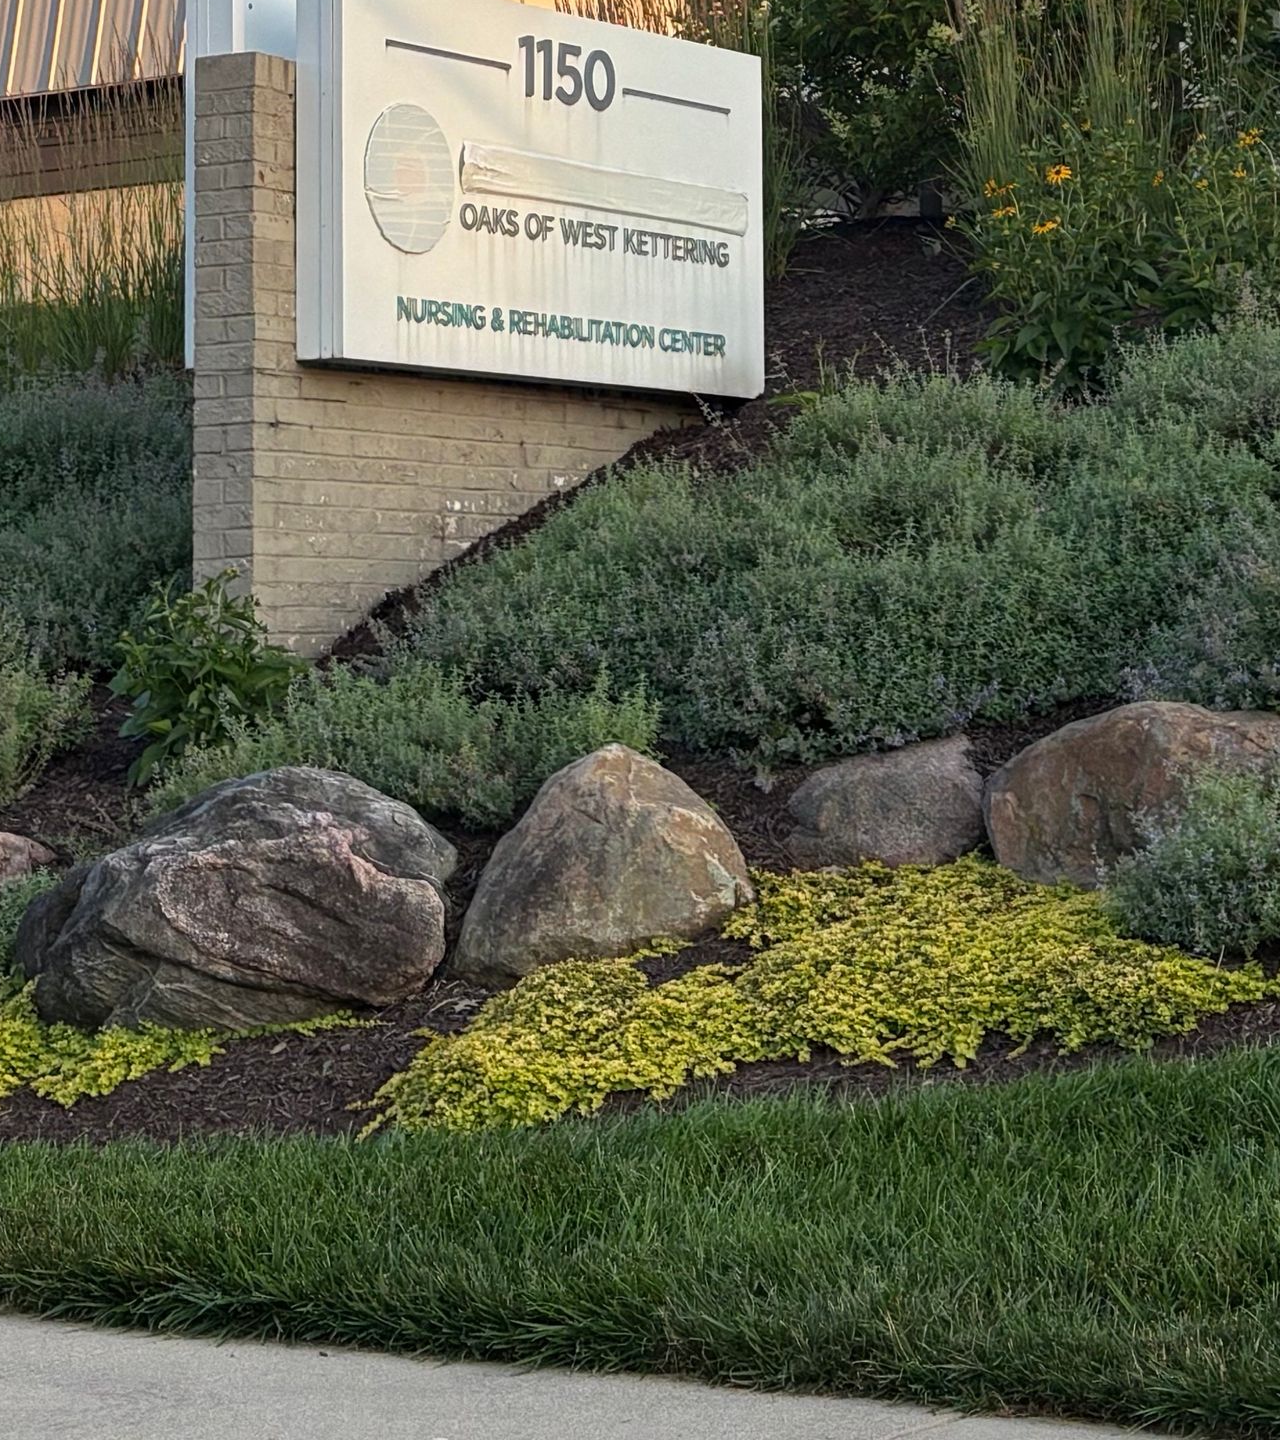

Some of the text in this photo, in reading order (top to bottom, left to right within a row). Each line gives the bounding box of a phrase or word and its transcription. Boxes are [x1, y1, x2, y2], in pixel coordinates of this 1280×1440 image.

[518, 35, 616, 111] 1150
[459, 203, 730, 268] OAKS OF WEST KETTERING
[396, 296, 726, 358] NURSING & REHABILITATION CENTER
